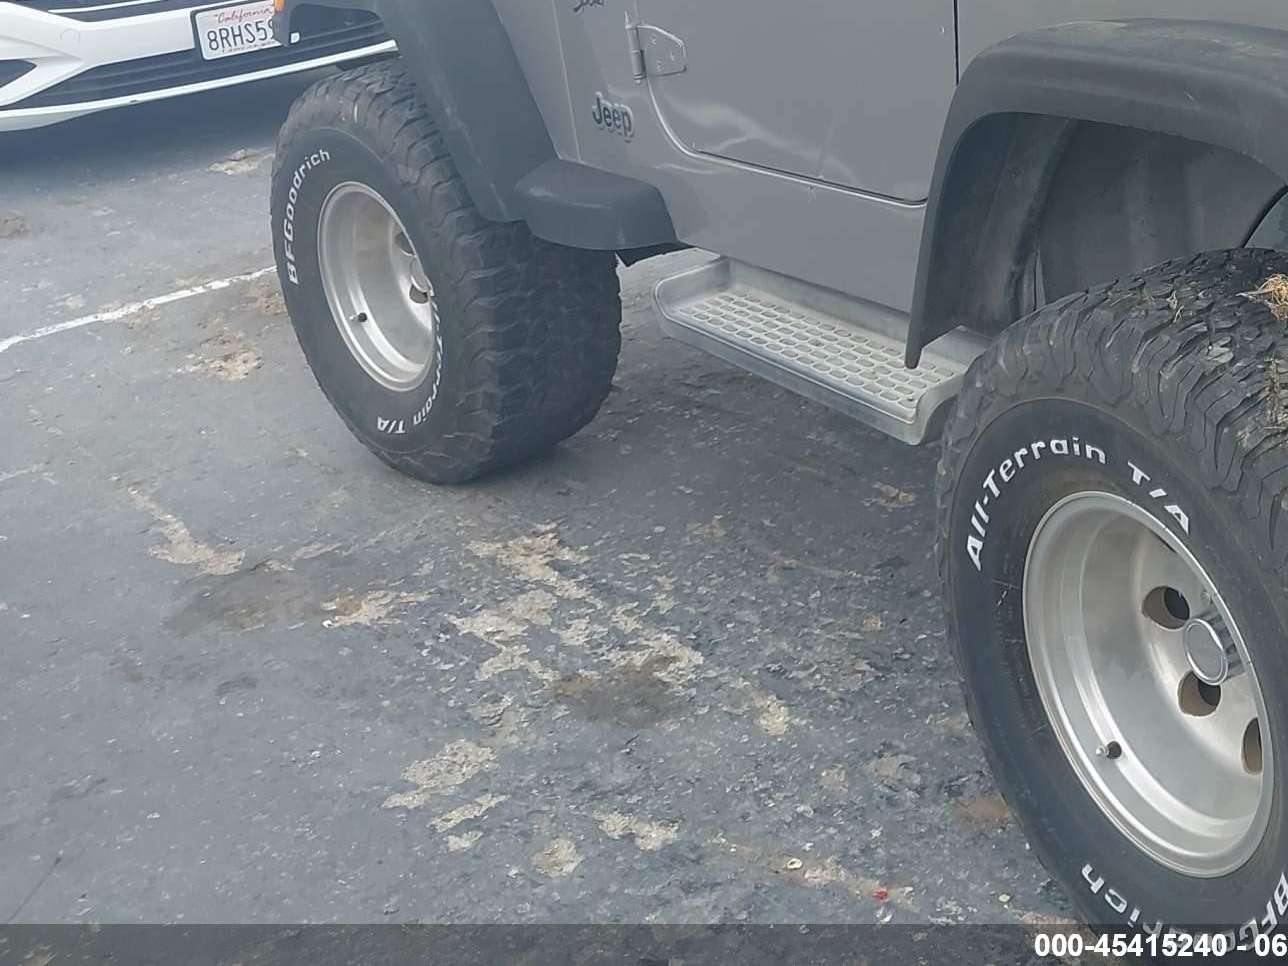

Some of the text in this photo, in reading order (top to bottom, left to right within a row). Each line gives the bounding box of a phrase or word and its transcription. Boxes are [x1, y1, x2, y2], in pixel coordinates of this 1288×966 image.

[213, 7, 273, 24] California
[592, 95, 633, 139] Jeep
[282, 148, 331, 286] BFGoodrich
[376, 416, 405, 434] T/A
[966, 436, 1190, 571] All-Terrain T/A
